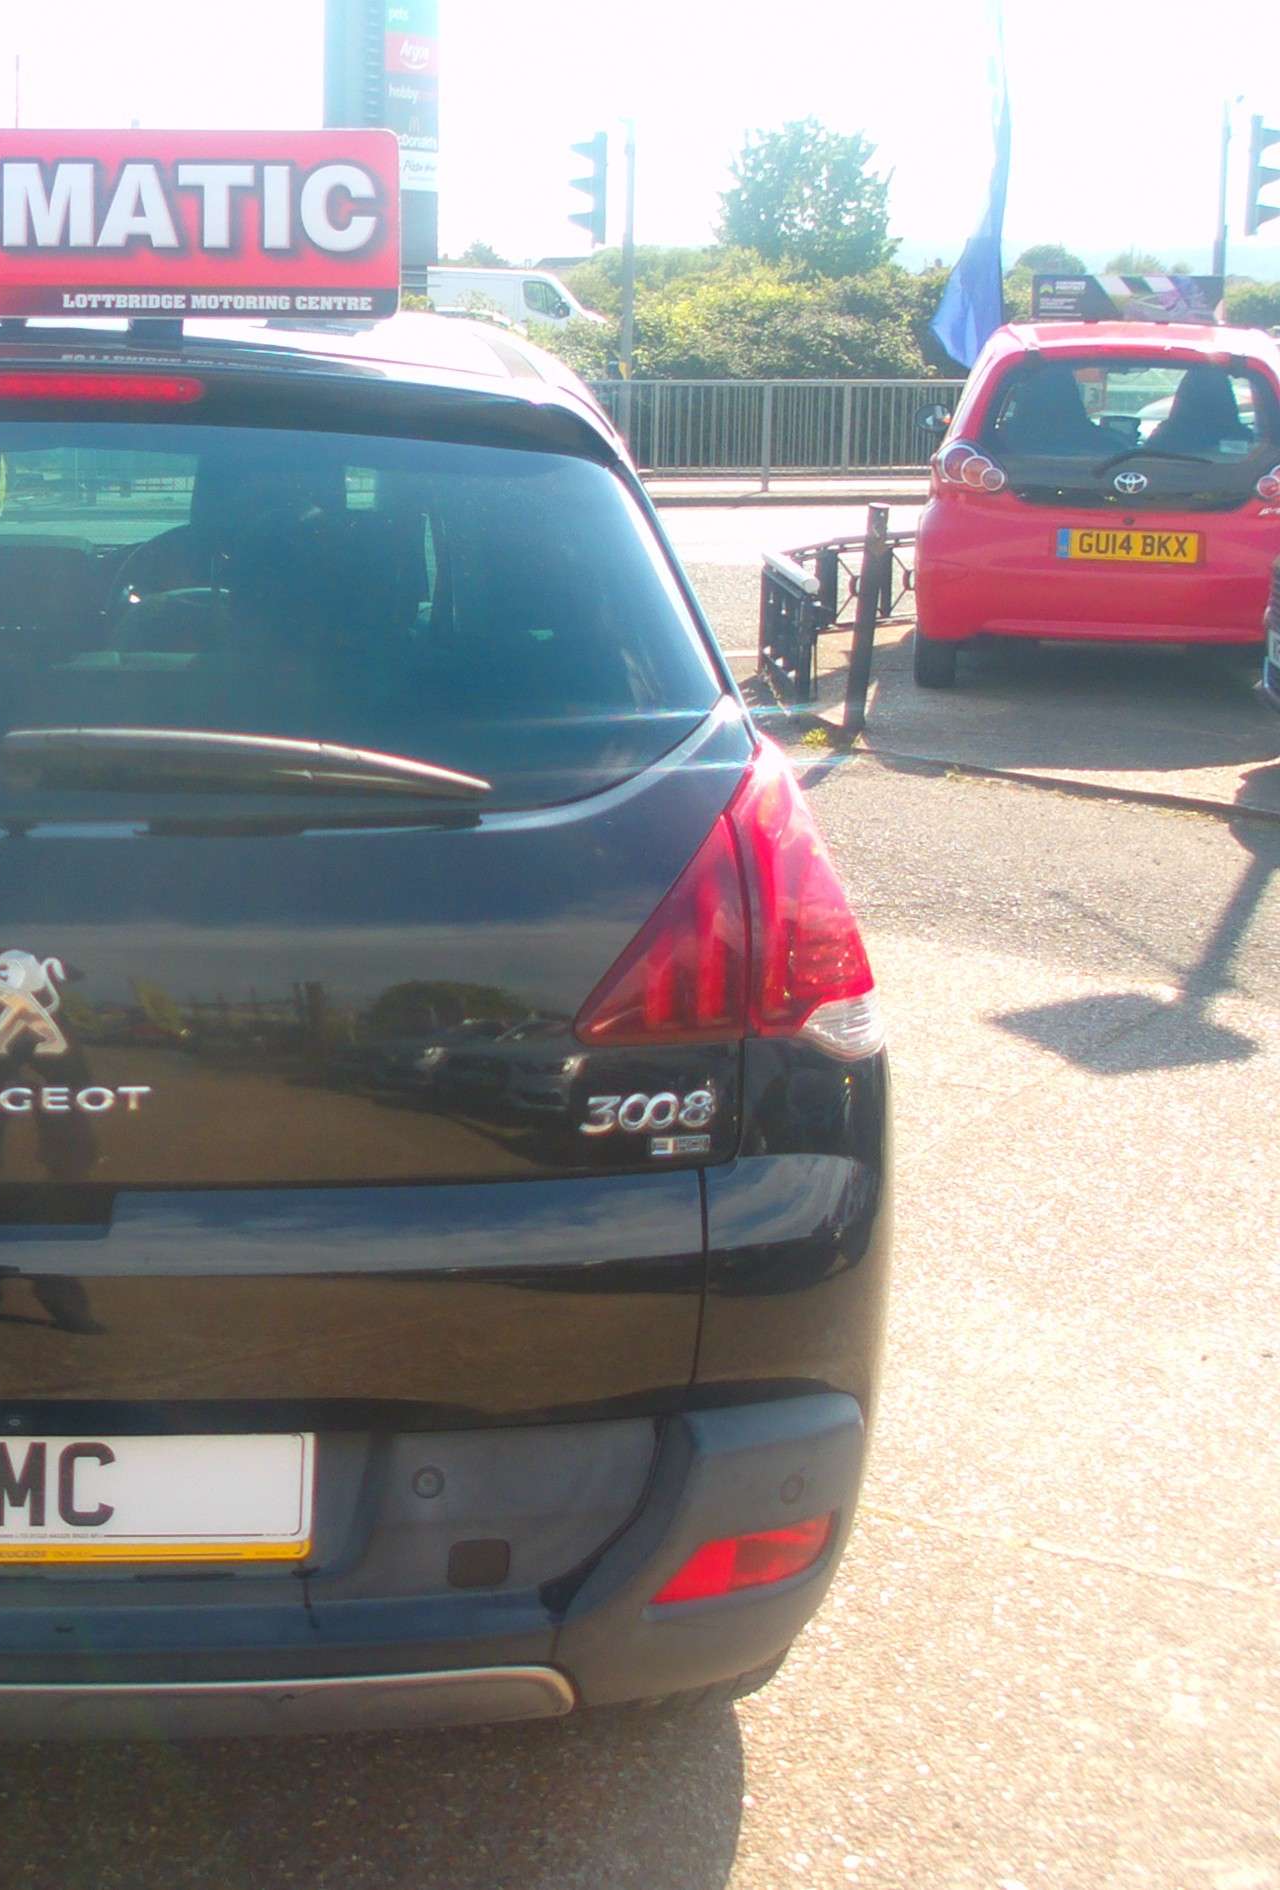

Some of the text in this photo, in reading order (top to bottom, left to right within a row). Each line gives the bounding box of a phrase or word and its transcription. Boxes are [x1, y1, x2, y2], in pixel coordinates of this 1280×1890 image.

[62, 293, 372, 311] LOTTBRIDGE MOTORING CENTRE
[1078, 532, 1188, 558] GU14 BKX
[578, 1090, 713, 1133] 3008
